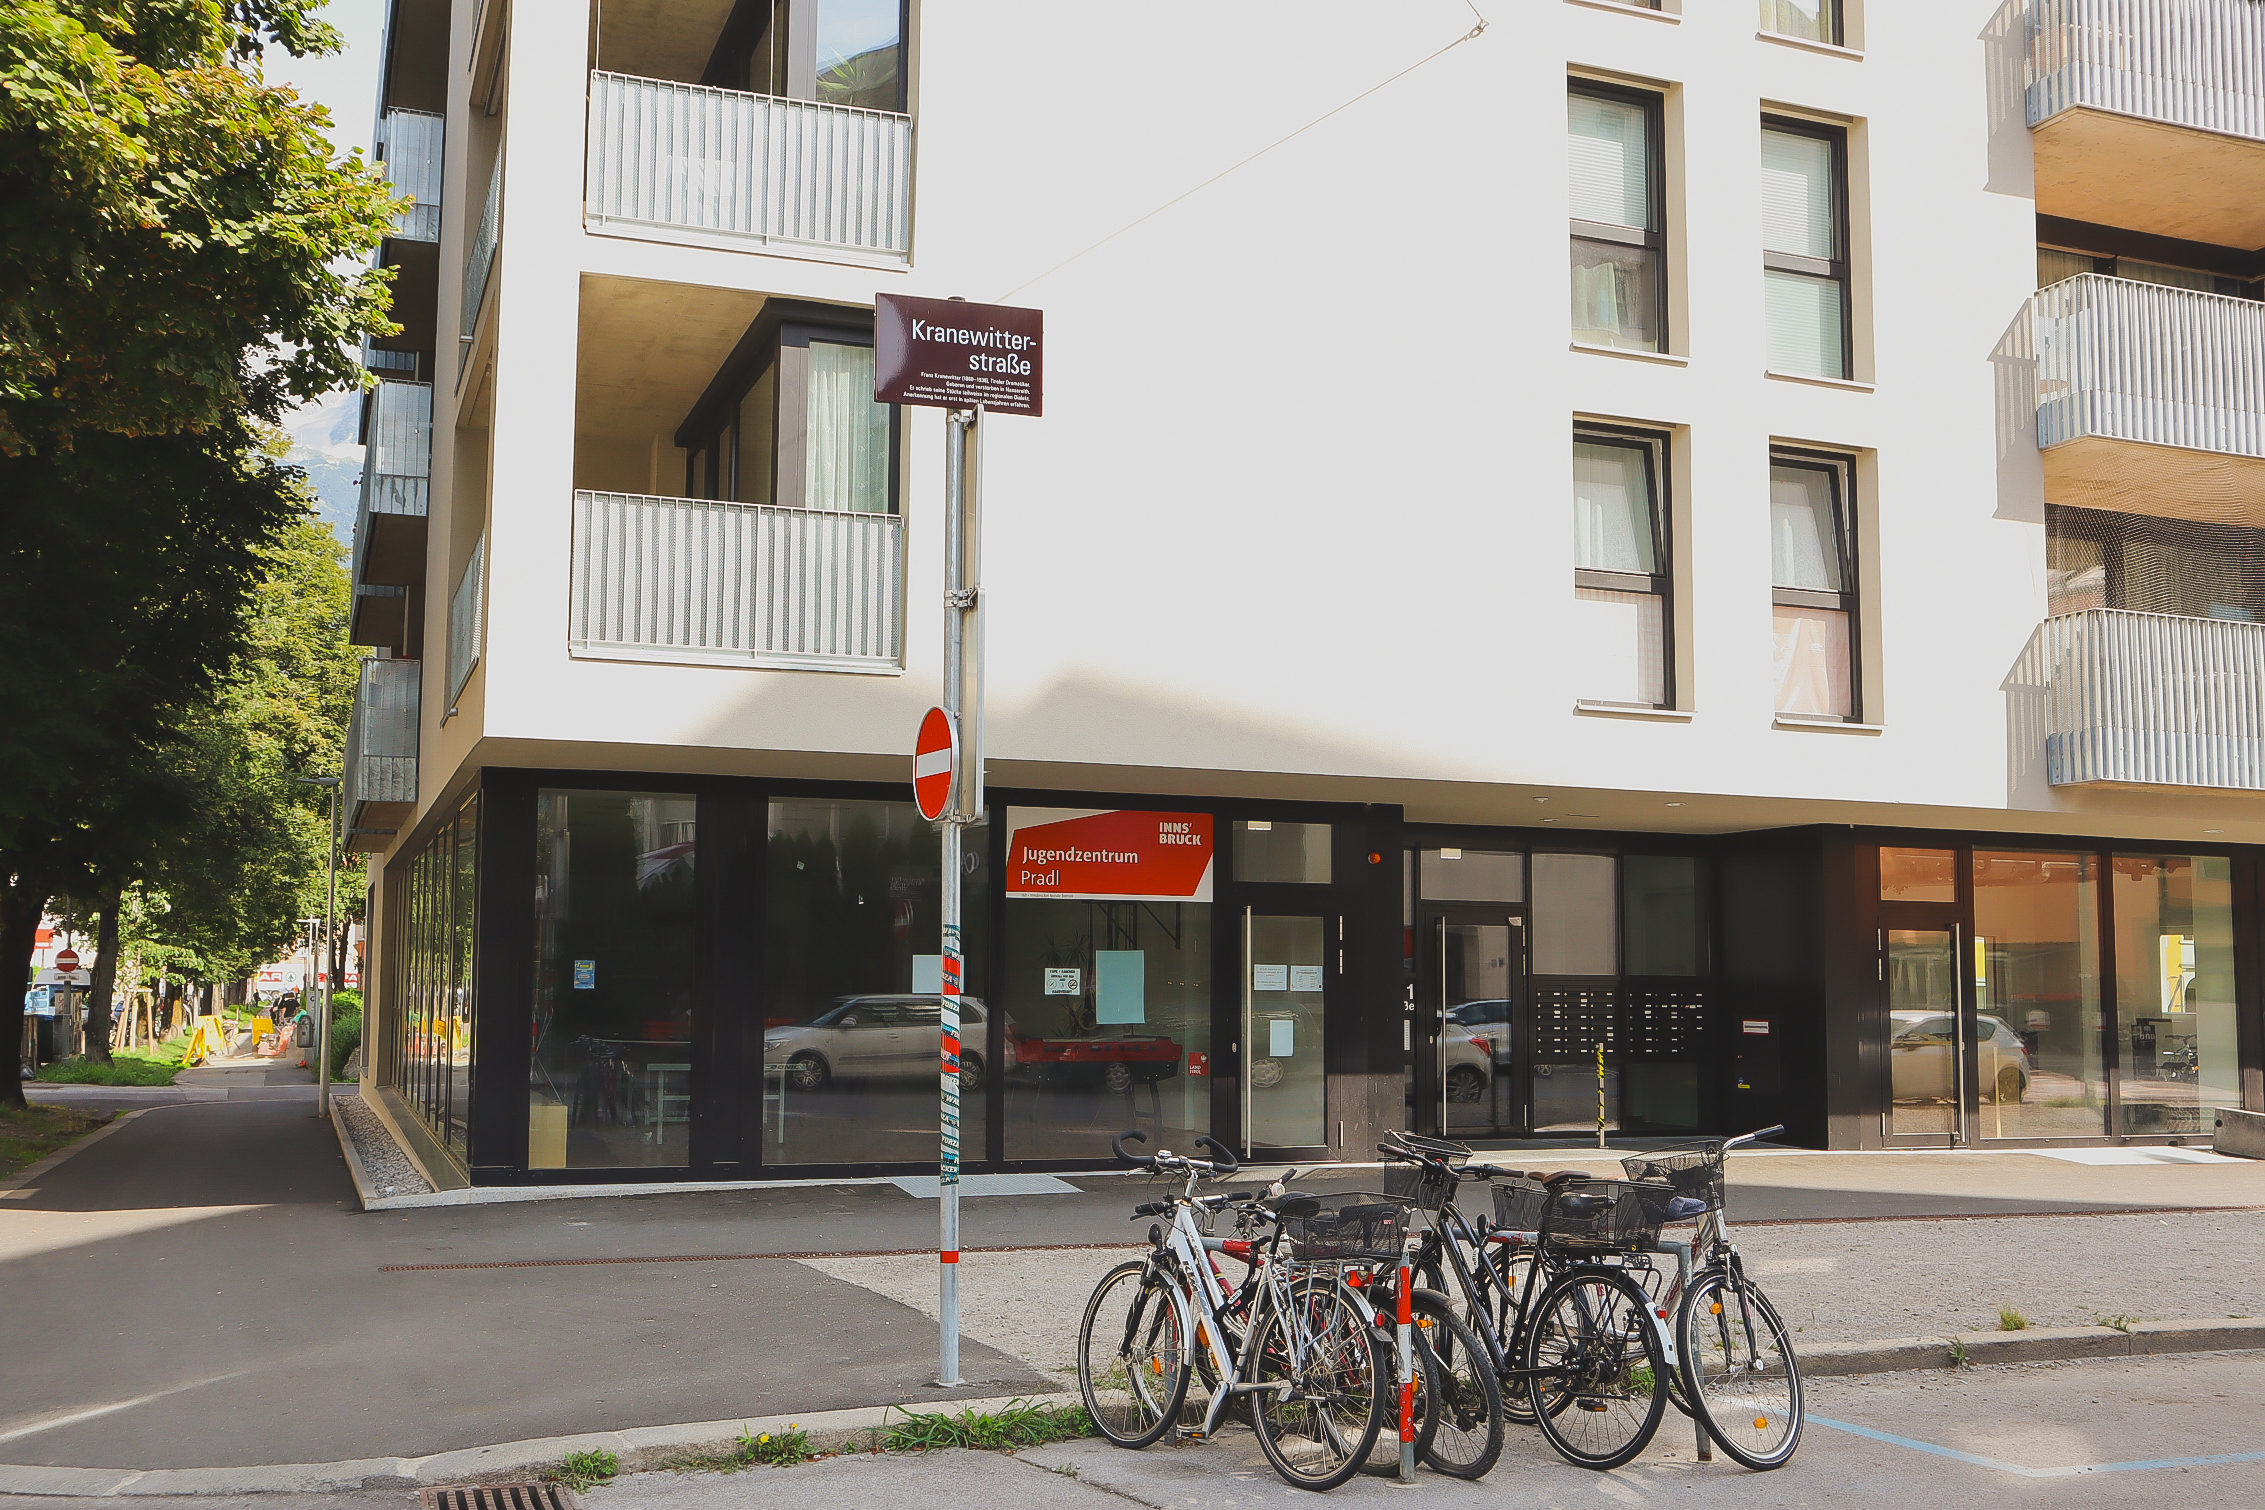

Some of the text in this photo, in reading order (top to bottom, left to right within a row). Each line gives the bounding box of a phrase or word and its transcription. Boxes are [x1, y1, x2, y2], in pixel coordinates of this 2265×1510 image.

[912, 318, 1037, 351] Kranewitter-
[969, 353, 1031, 375] straße
[1159, 834, 1202, 846] BRUCK
[1022, 846, 1139, 865] Jugendzentrum
[1021, 869, 1060, 886] Pradl
[259, 972, 283, 981] AR
